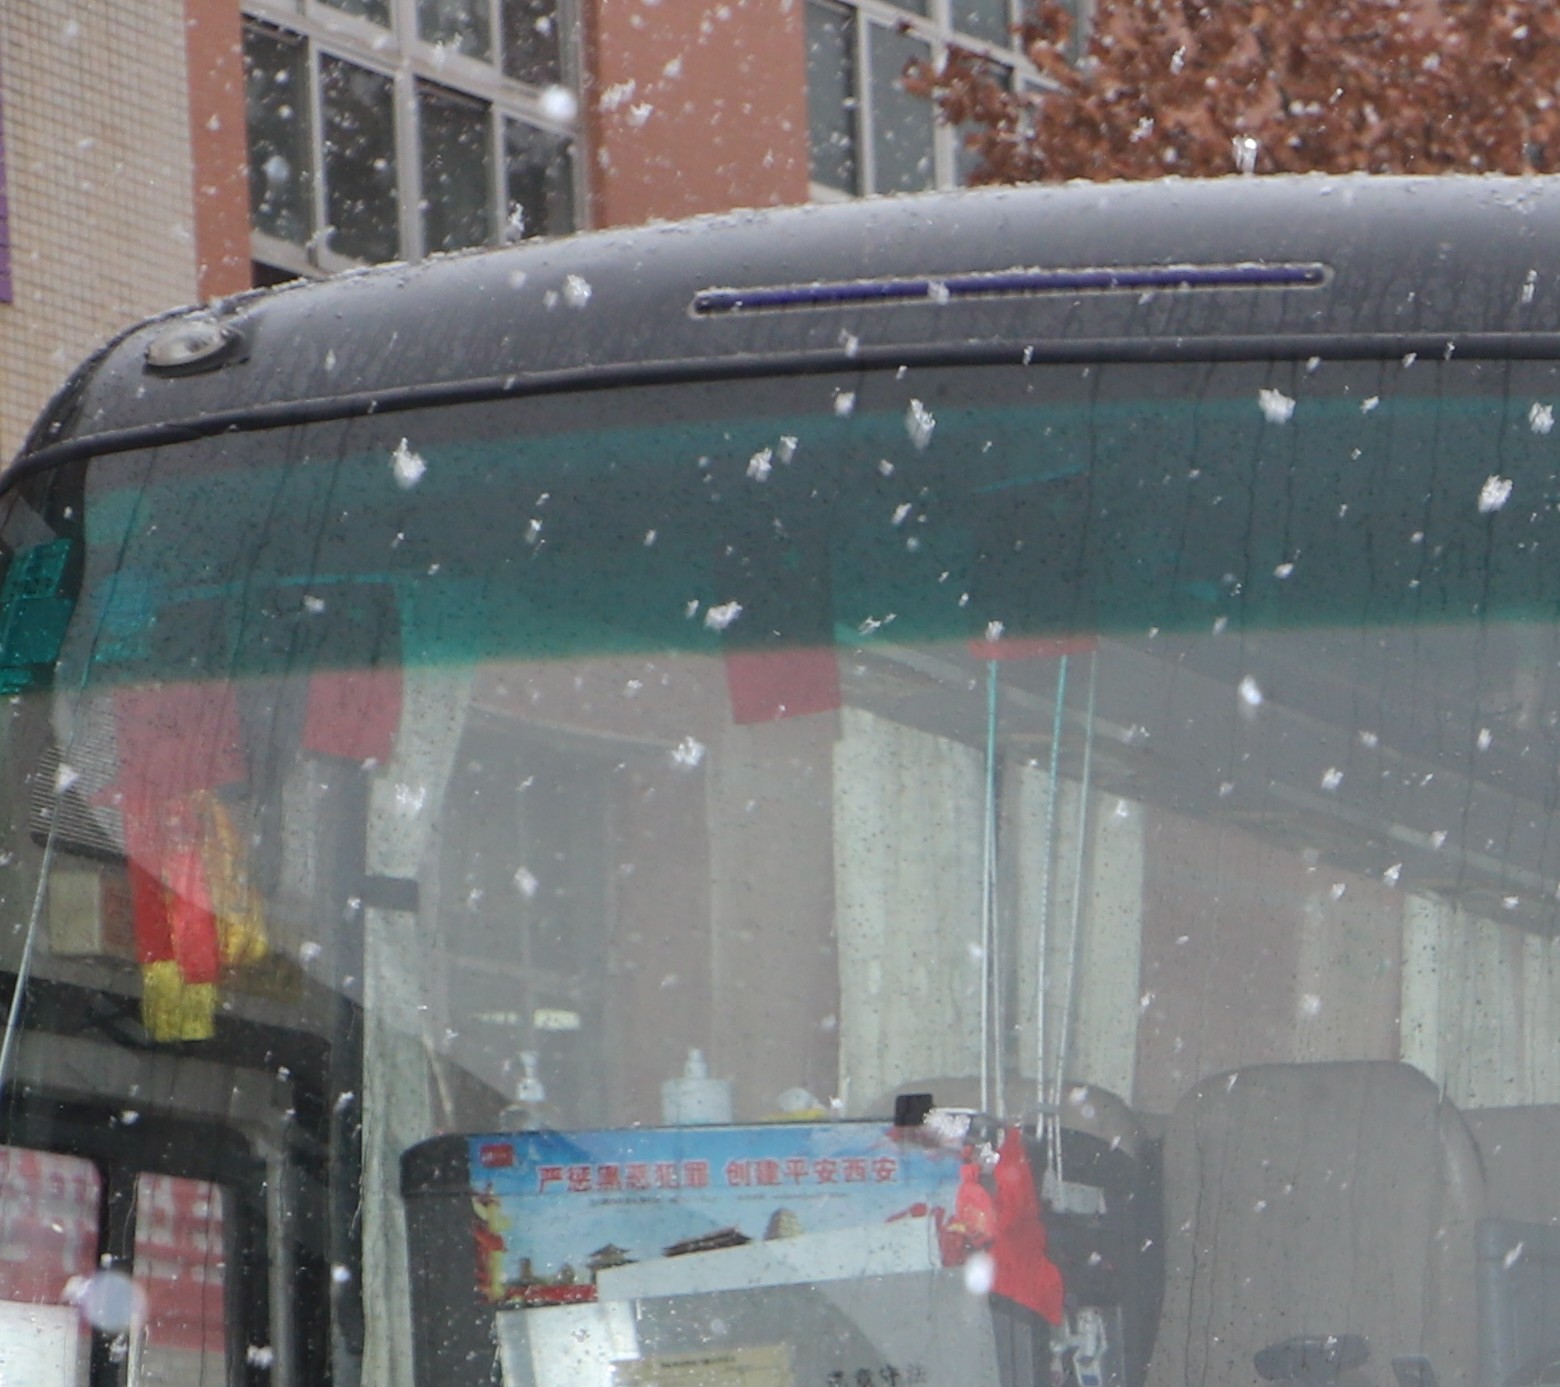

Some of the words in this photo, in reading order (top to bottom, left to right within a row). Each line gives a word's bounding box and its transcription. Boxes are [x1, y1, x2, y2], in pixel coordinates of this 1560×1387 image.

[726, 1156, 897, 1187] 创建平安西安
